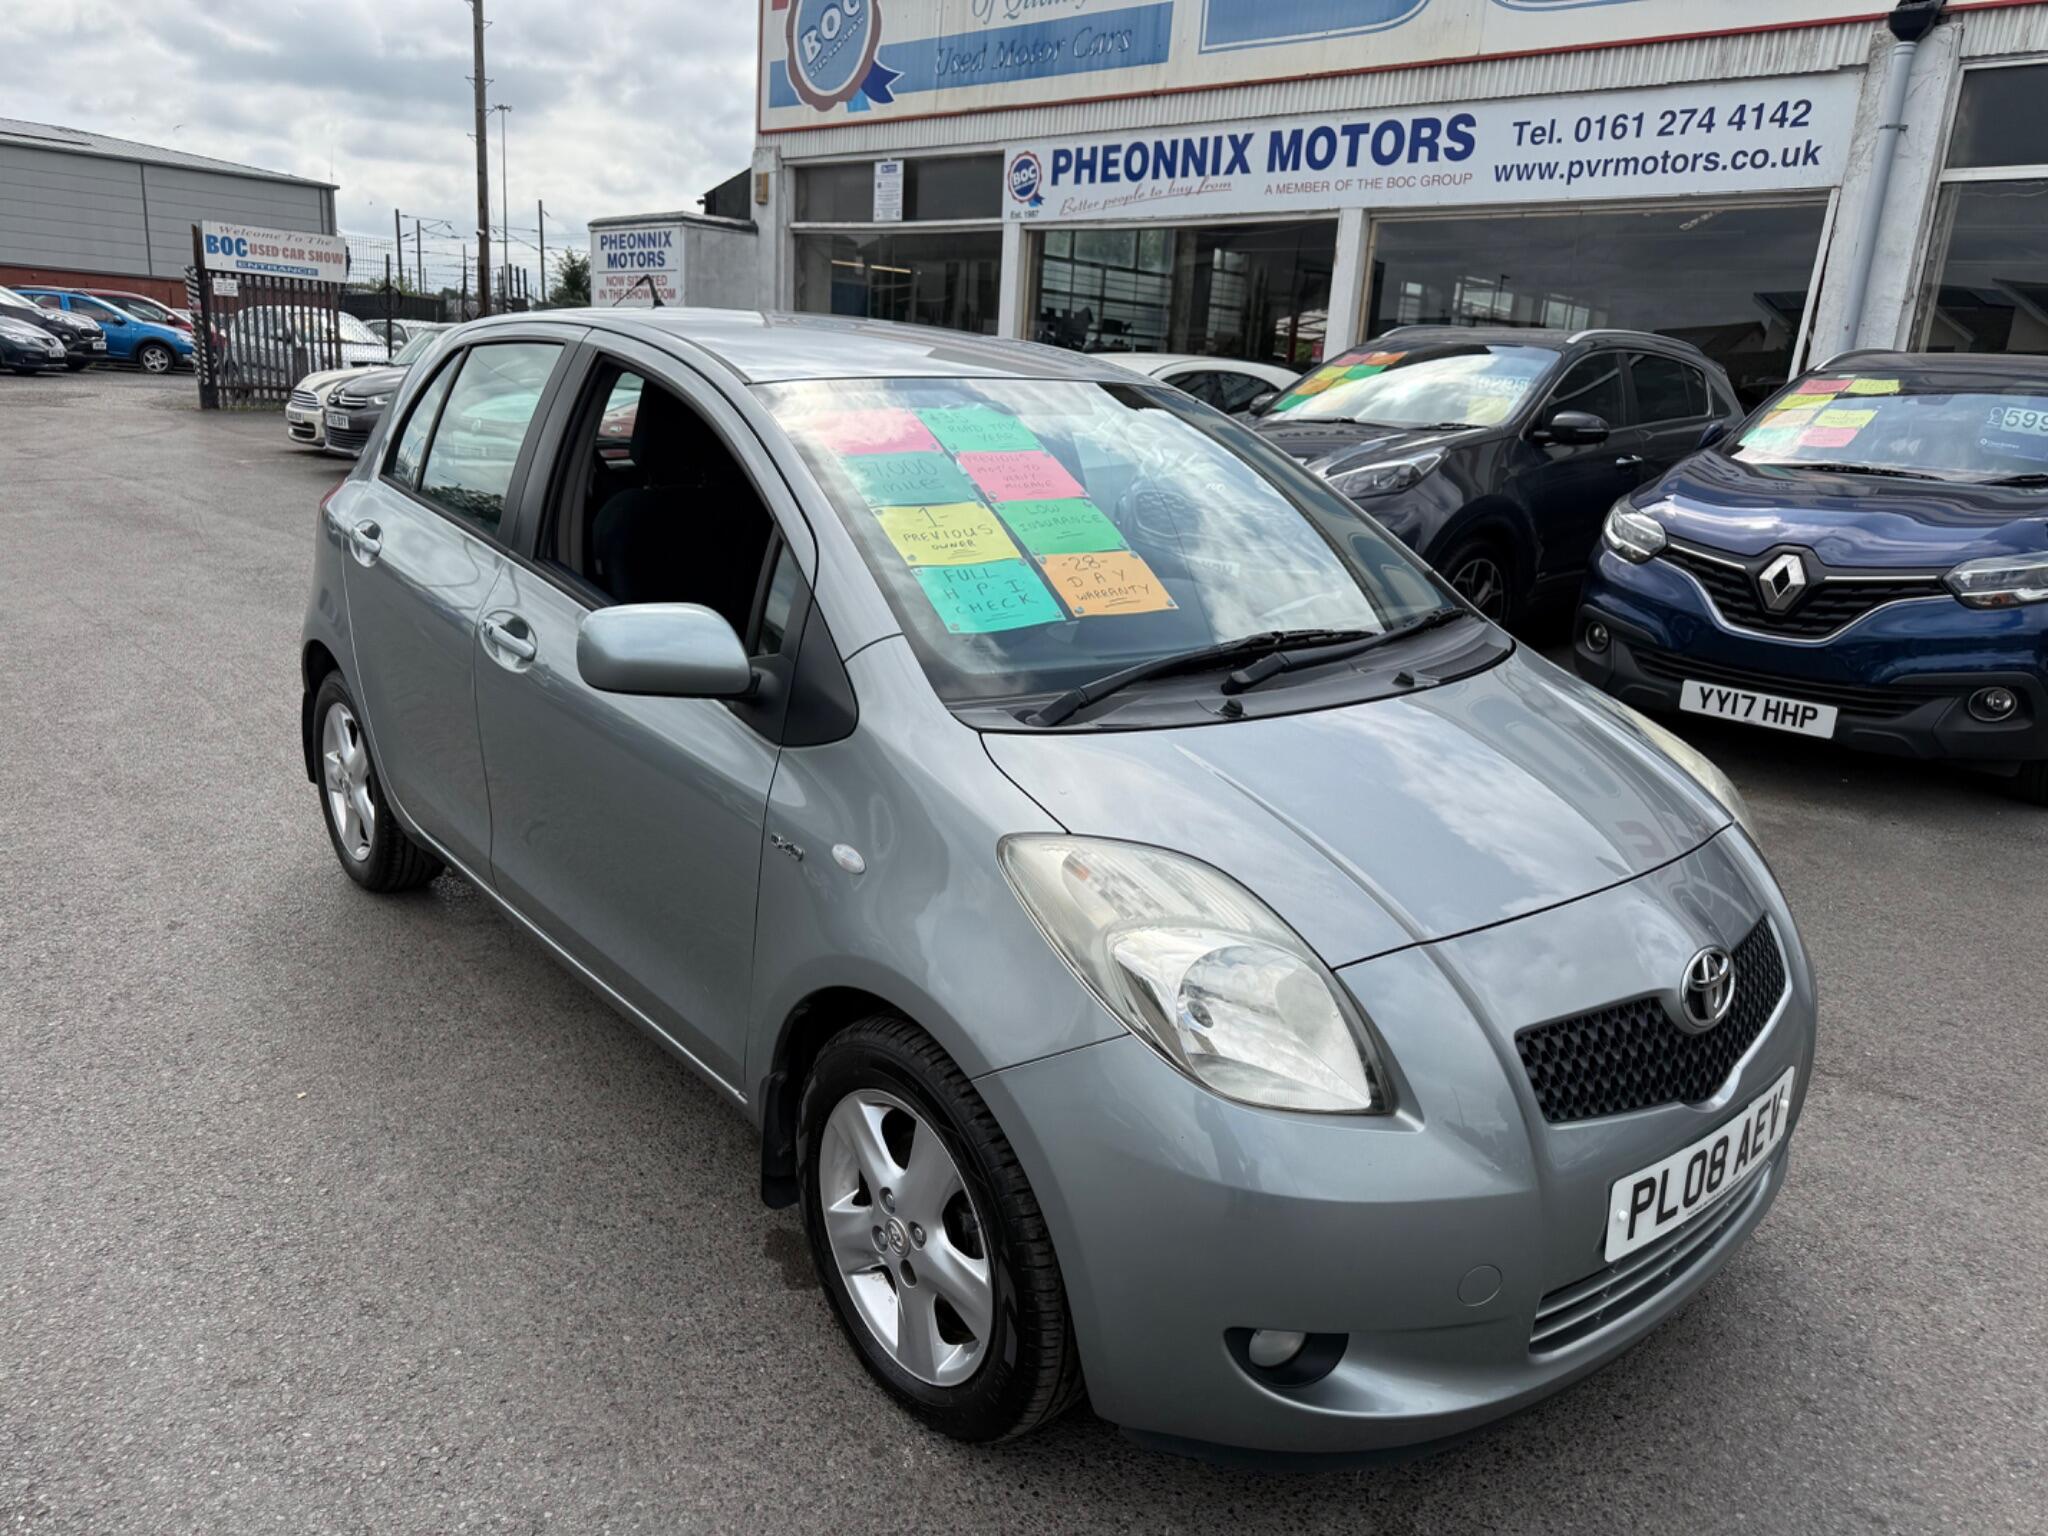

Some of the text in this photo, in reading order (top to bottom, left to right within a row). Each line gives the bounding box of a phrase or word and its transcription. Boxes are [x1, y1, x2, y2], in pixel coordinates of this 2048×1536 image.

[934, 26, 1133, 76] Used Motor Cars
[1512, 98, 1813, 146] Tel. 0161 274 4142
[1050, 112, 1477, 187] PHEONNIX MOTORS
[1493, 139, 1824, 185] www.pvrmotors.co.uk
[1013, 165, 1037, 187] BOC
[1263, 172, 1473, 196] A MEMBER OF THE BOC GROUP
[1058, 173, 1233, 217] Better people to buy from
[219, 225, 332, 246] Welcome To The
[600, 231, 672, 251] PHEONNIX
[205, 234, 344, 265] BOC USED CAR SHOW
[607, 251, 666, 269] MOTORS
[237, 261, 319, 276] ENTRANCE
[606, 275, 668, 287] NOW SITED
[599, 290, 607, 299] IN
[625, 288, 676, 299] SHOWOOM
[902, 523, 994, 543] PREVIOUS
[943, 567, 1000, 584] FULL
[955, 592, 1039, 615] CHECK
[1075, 583, 1151, 602] WARRANTY
[1699, 686, 1818, 729] YY17 HHP
[1627, 1135, 1730, 1241] PL08
